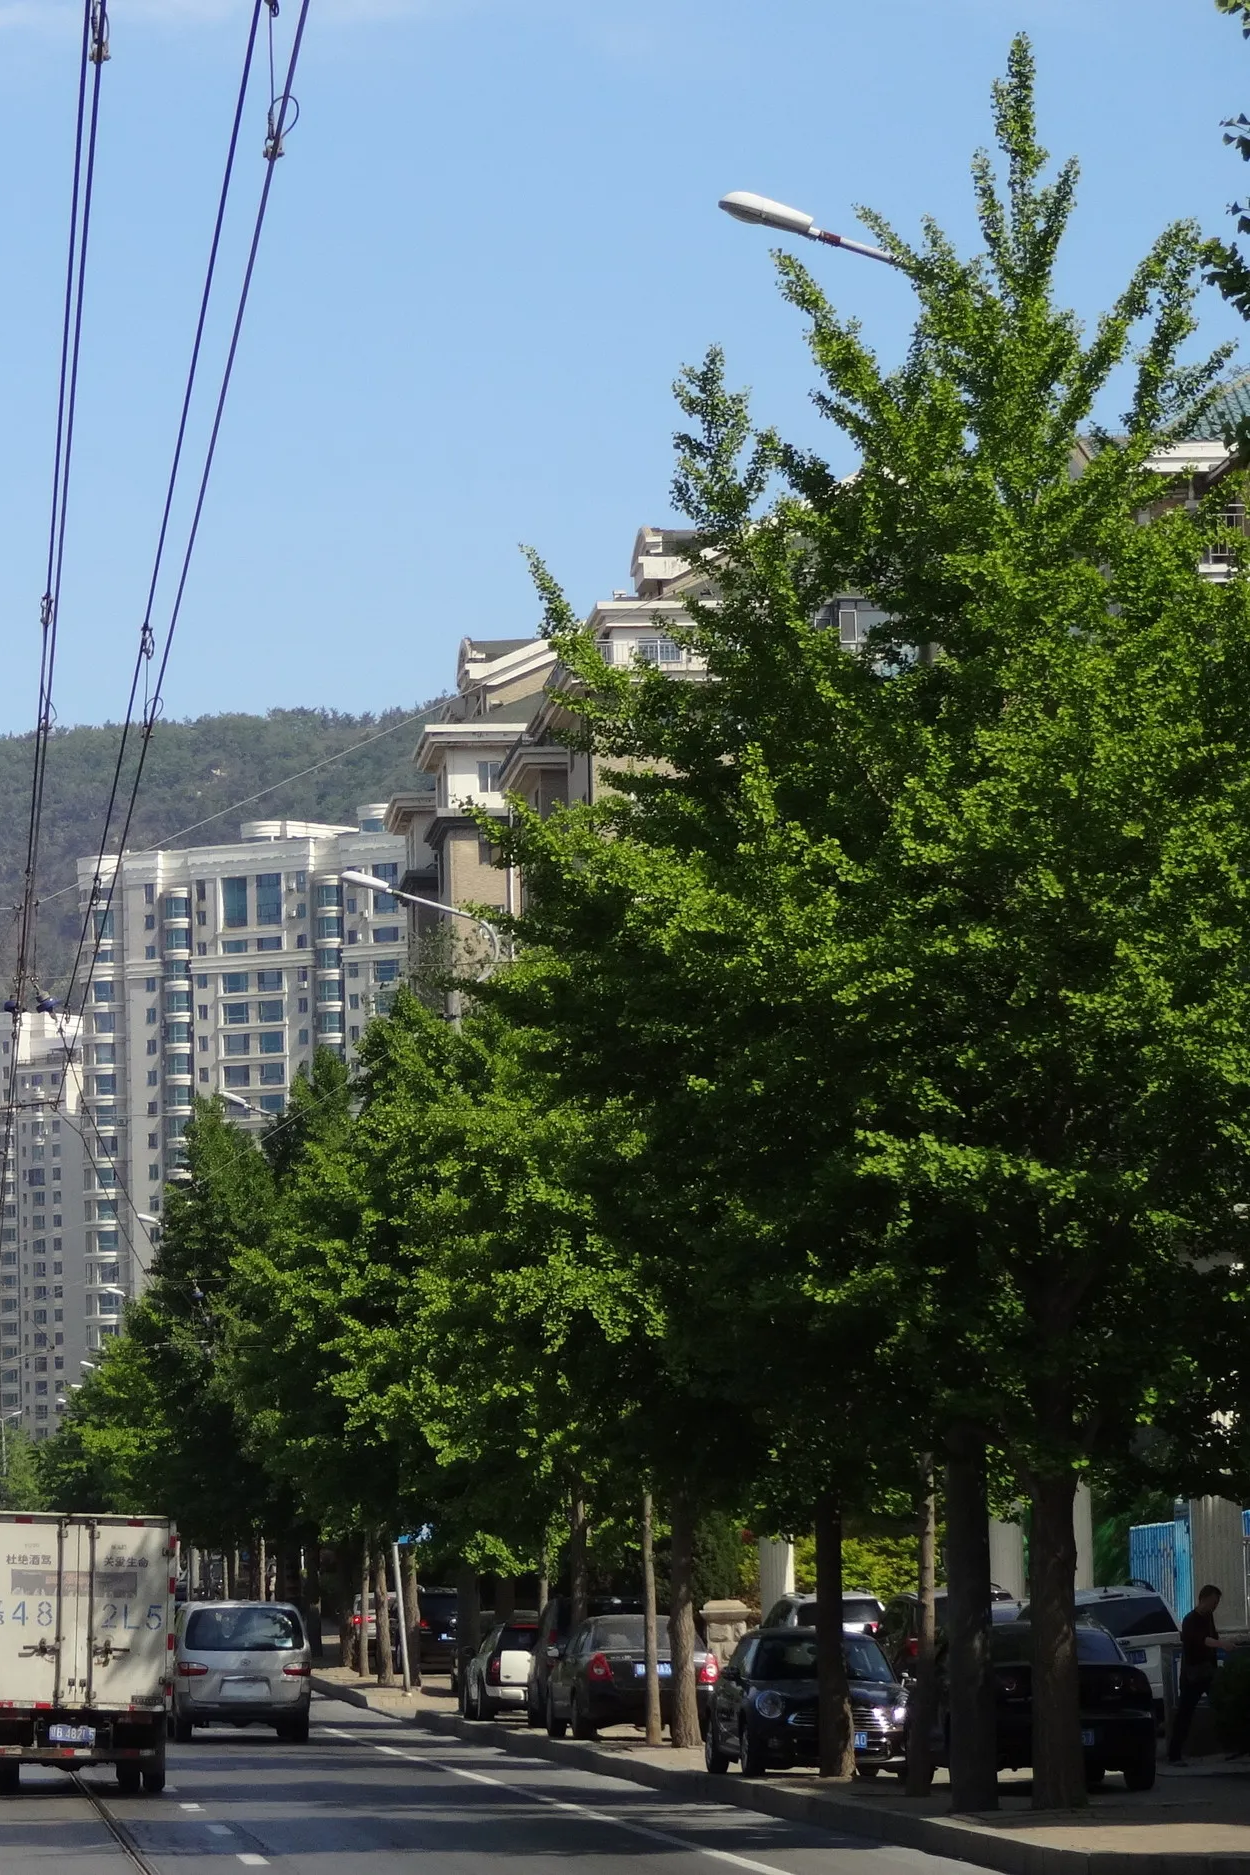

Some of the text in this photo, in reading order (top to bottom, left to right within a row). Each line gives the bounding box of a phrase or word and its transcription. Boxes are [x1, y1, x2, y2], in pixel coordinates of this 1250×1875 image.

[6, 1554, 52, 1566] 杜绝酒驾
[104, 1556, 149, 1568] 关爱生命
